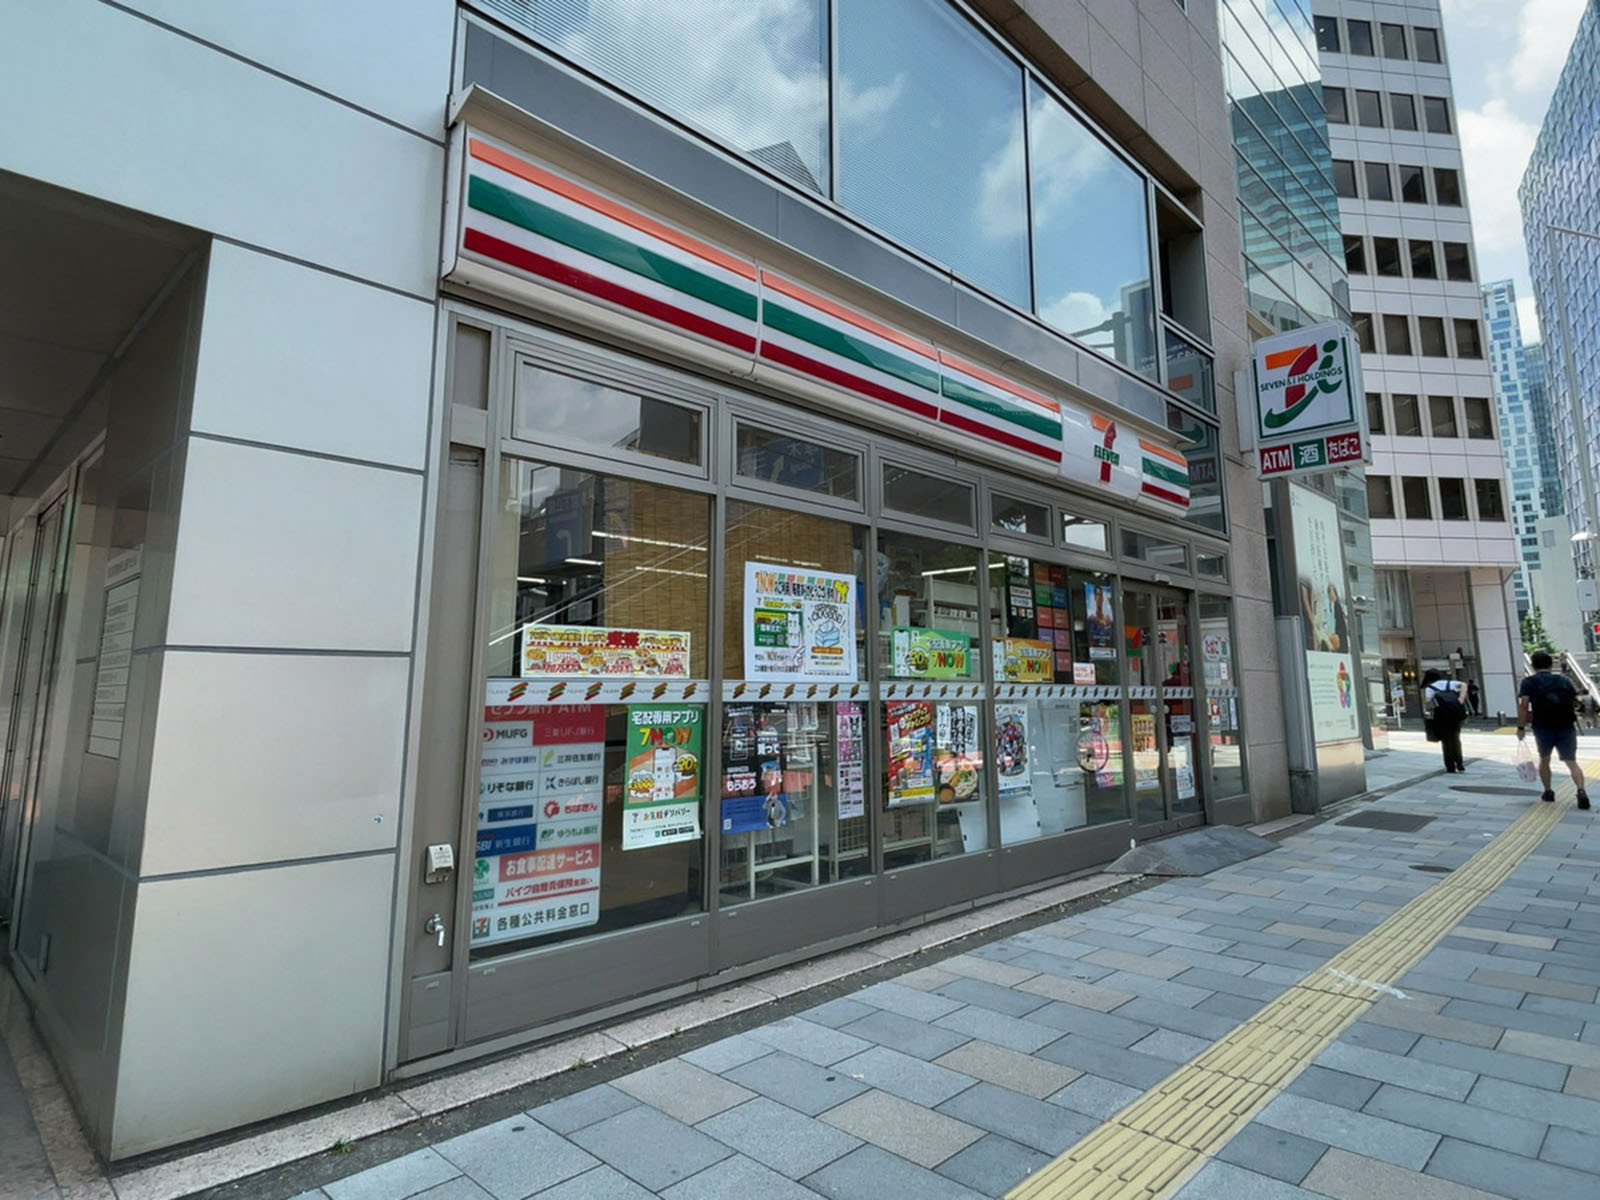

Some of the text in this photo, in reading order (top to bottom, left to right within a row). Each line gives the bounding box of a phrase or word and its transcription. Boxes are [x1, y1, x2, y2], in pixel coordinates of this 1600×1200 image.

[1260, 379, 1286, 392] SEVEN
[1297, 366, 1343, 382] HOLDINGS
[1262, 448, 1291, 471] ATM
[1298, 443, 1320, 465] 酒
[1328, 437, 1361, 460] たばこ
[931, 650, 965, 668] 7NOW
[496, 728, 528, 739] MUFG
[640, 727, 692, 746] 7NOW
[487, 780, 534, 793] りそな銀行
[556, 825, 599, 838] ゆうちょ銀行
[506, 848, 593, 876] お食事配達サービス
[497, 902, 591, 932] 各種公共料金窓口
